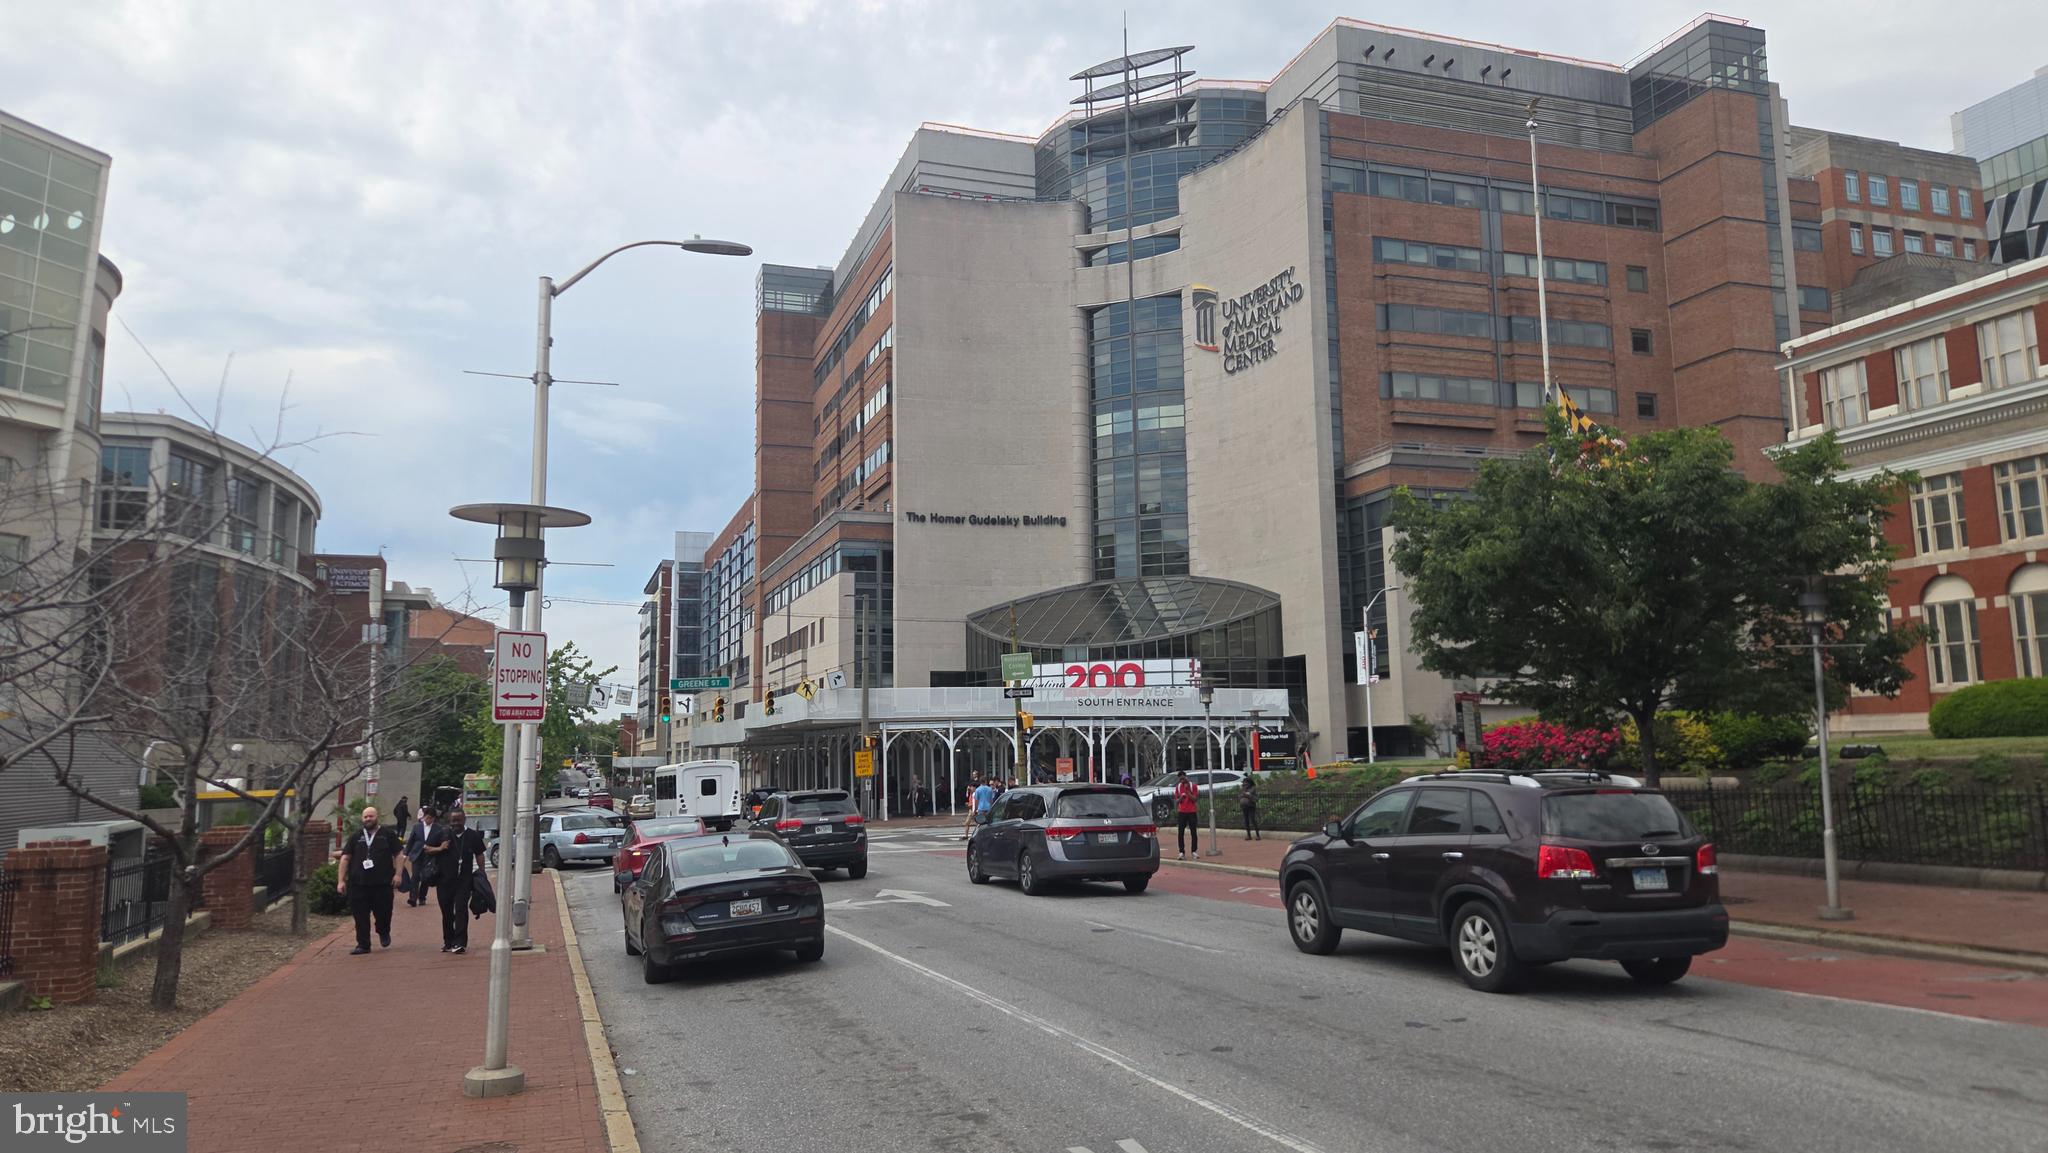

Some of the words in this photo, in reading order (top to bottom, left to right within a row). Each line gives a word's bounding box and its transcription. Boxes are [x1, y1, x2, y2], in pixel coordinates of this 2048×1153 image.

[1222, 265, 1296, 319] UNIVERSITY
[1222, 320, 1234, 338] of
[1234, 283, 1305, 334] MARYLAND
[1223, 316, 1283, 357] MEDICAL
[1223, 340, 1278, 375] CENTER
[906, 512, 926, 523] The
[930, 513, 965, 525] Homer
[968, 514, 1020, 527] Gudelsky
[1023, 515, 1067, 527] Building
[512, 643, 531, 658] NO
[499, 669, 542, 684] STOPPING
[678, 680, 710, 688] GREENE
[1065, 663, 1145, 697] 200
[1078, 699, 1113, 707] SOUTH
[1117, 698, 1174, 707] ENTRANCE
